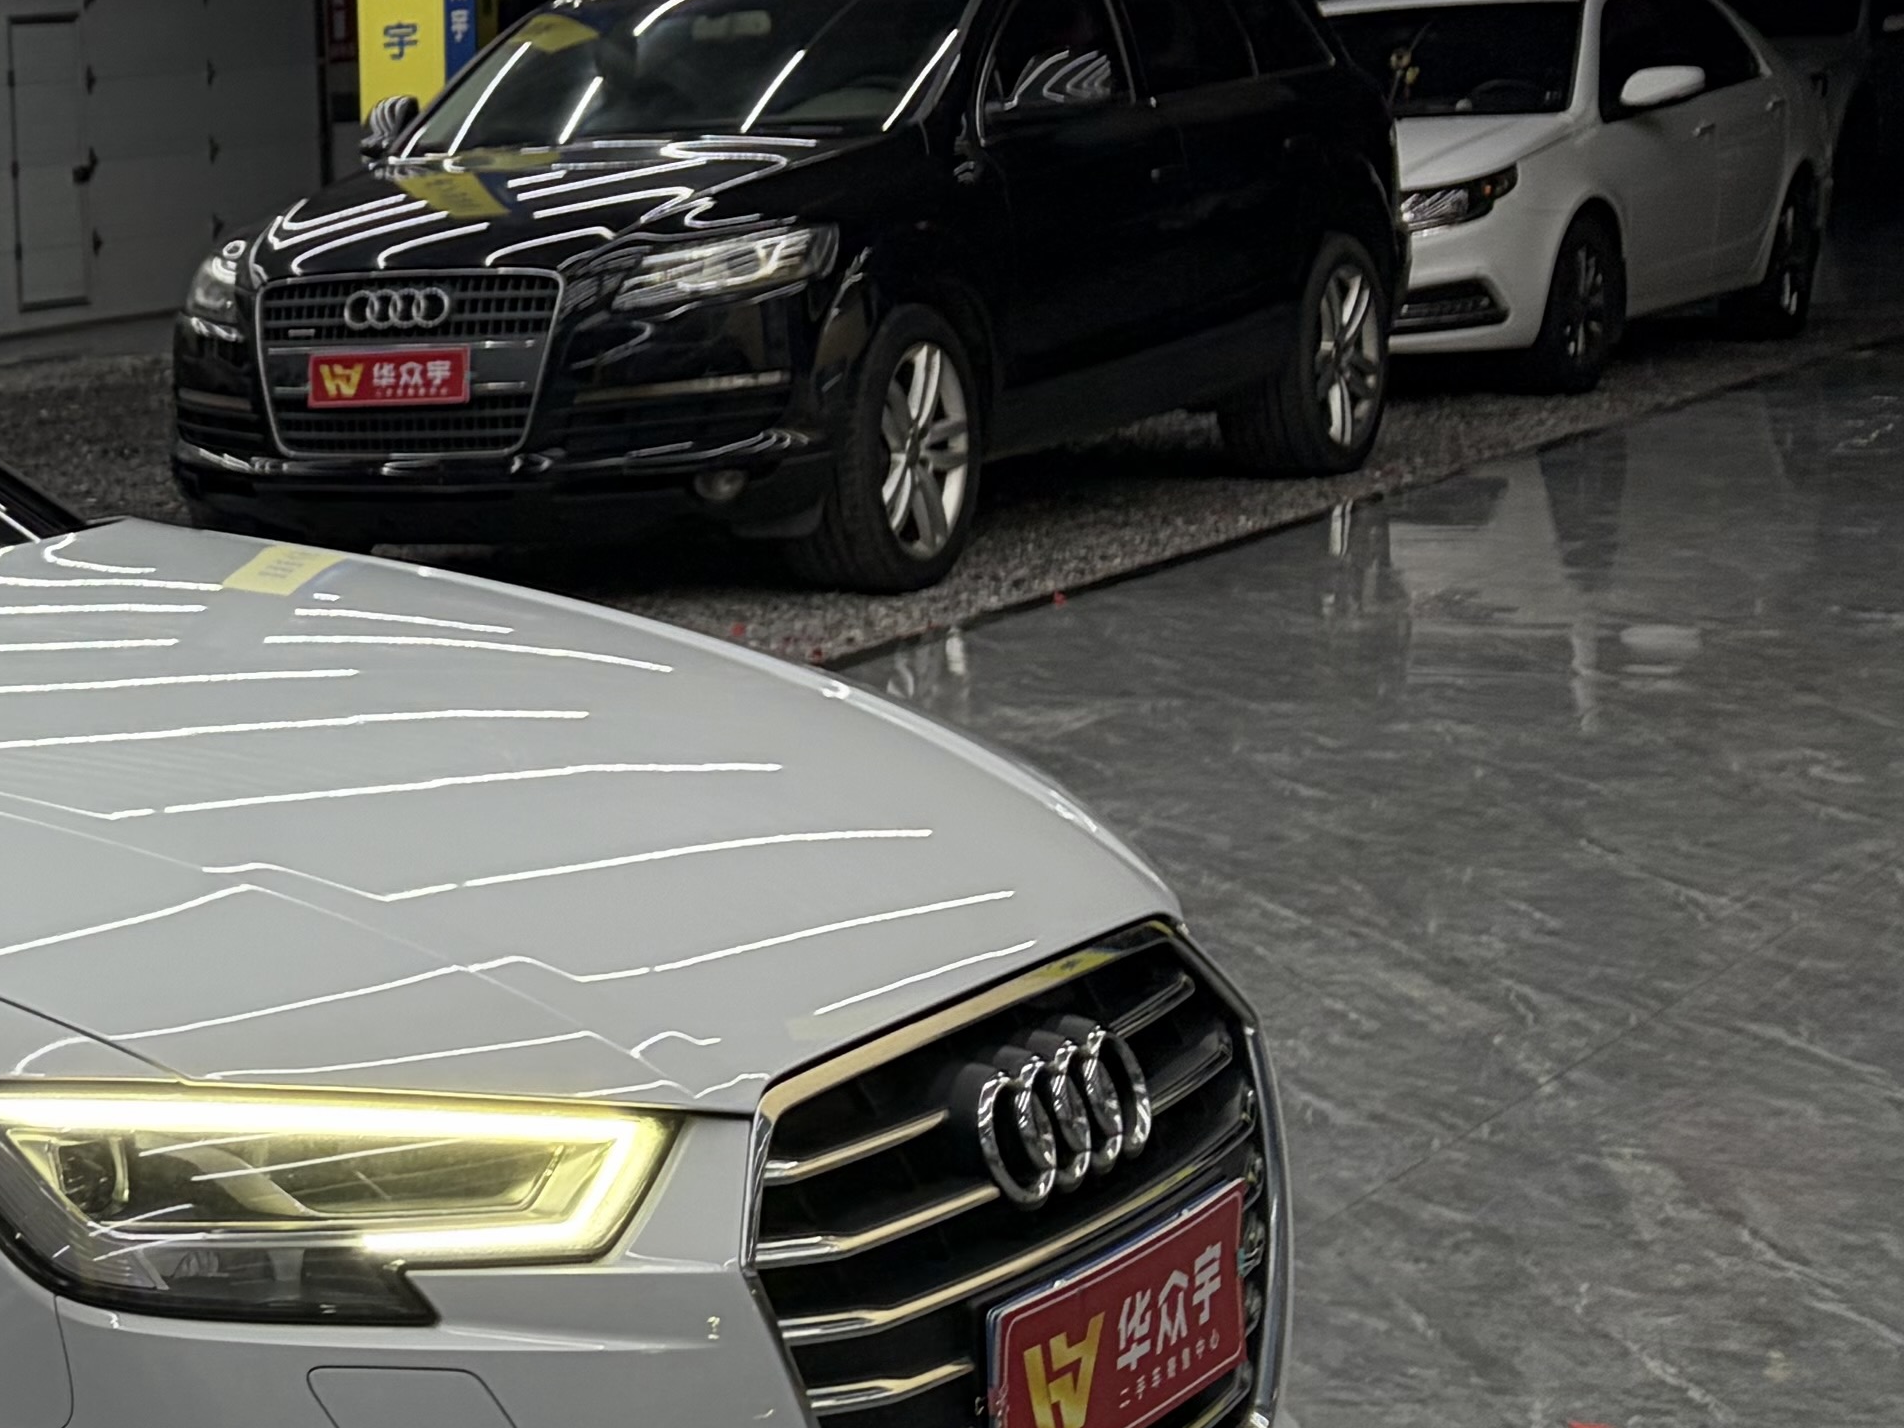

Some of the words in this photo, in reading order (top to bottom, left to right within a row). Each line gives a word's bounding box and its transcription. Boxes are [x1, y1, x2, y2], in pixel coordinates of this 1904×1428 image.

[371, 360, 452, 388] 华众宇
[1116, 1241, 1222, 1371] 华众宇
